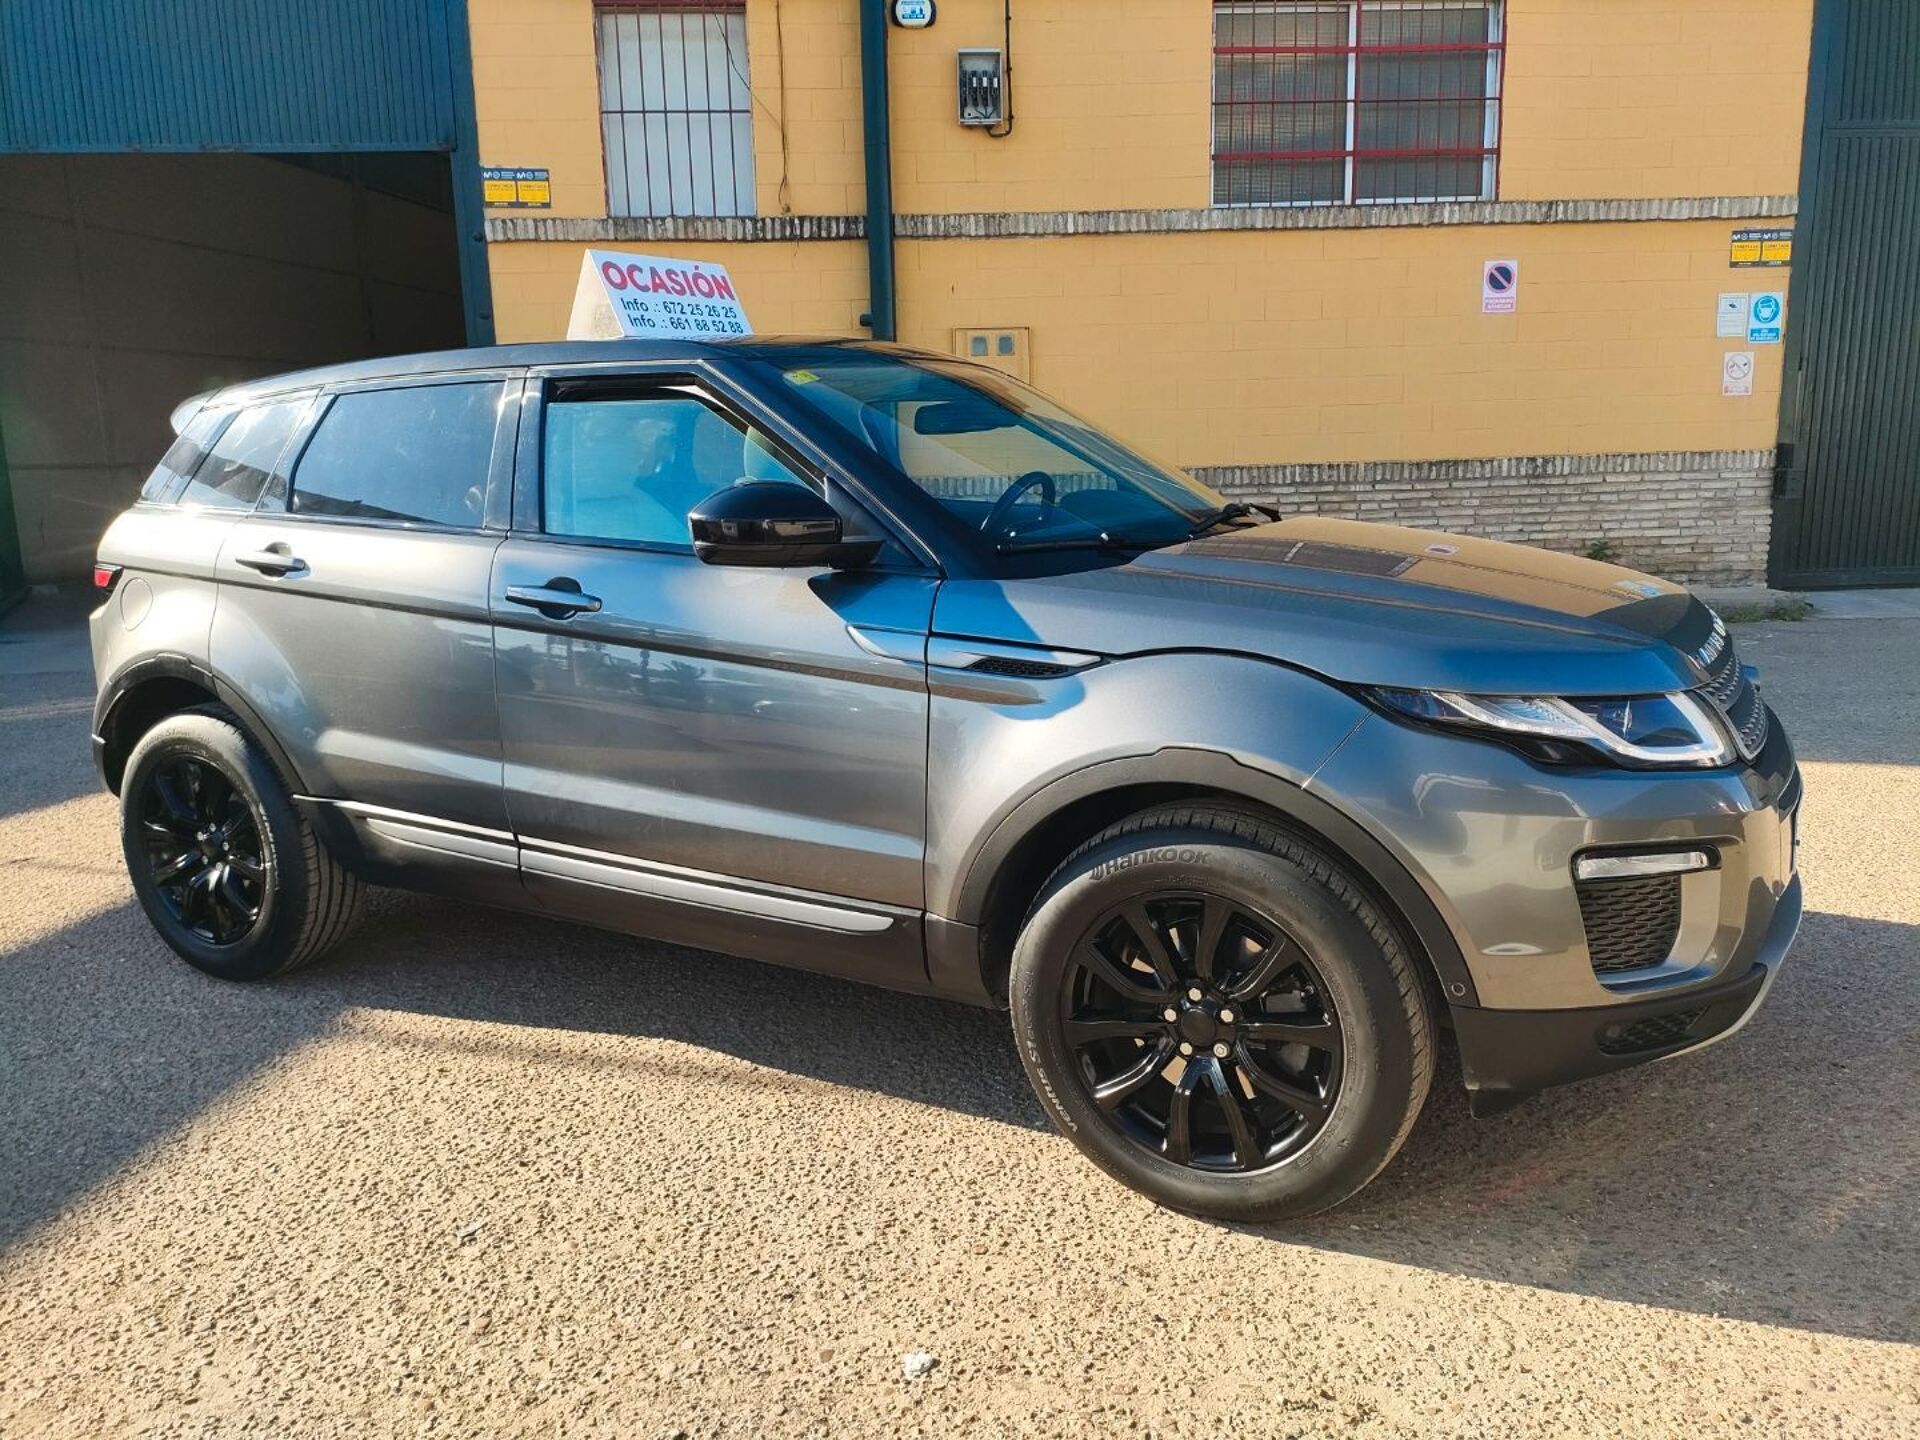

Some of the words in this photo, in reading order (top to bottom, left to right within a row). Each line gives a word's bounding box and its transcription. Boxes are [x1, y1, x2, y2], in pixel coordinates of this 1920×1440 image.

[602, 261, 735, 300] OCASIÓN
[621, 298, 649, 312] Info
[663, 301, 686, 315] 672
[688, 303, 704, 316] 25
[705, 304, 721, 318] 26
[722, 306, 737, 319] 25
[628, 314, 656, 328] Info
[670, 317, 692, 330] 661
[695, 319, 710, 331] 88
[712, 320, 727, 332] 52
[728, 321, 744, 334] 88
